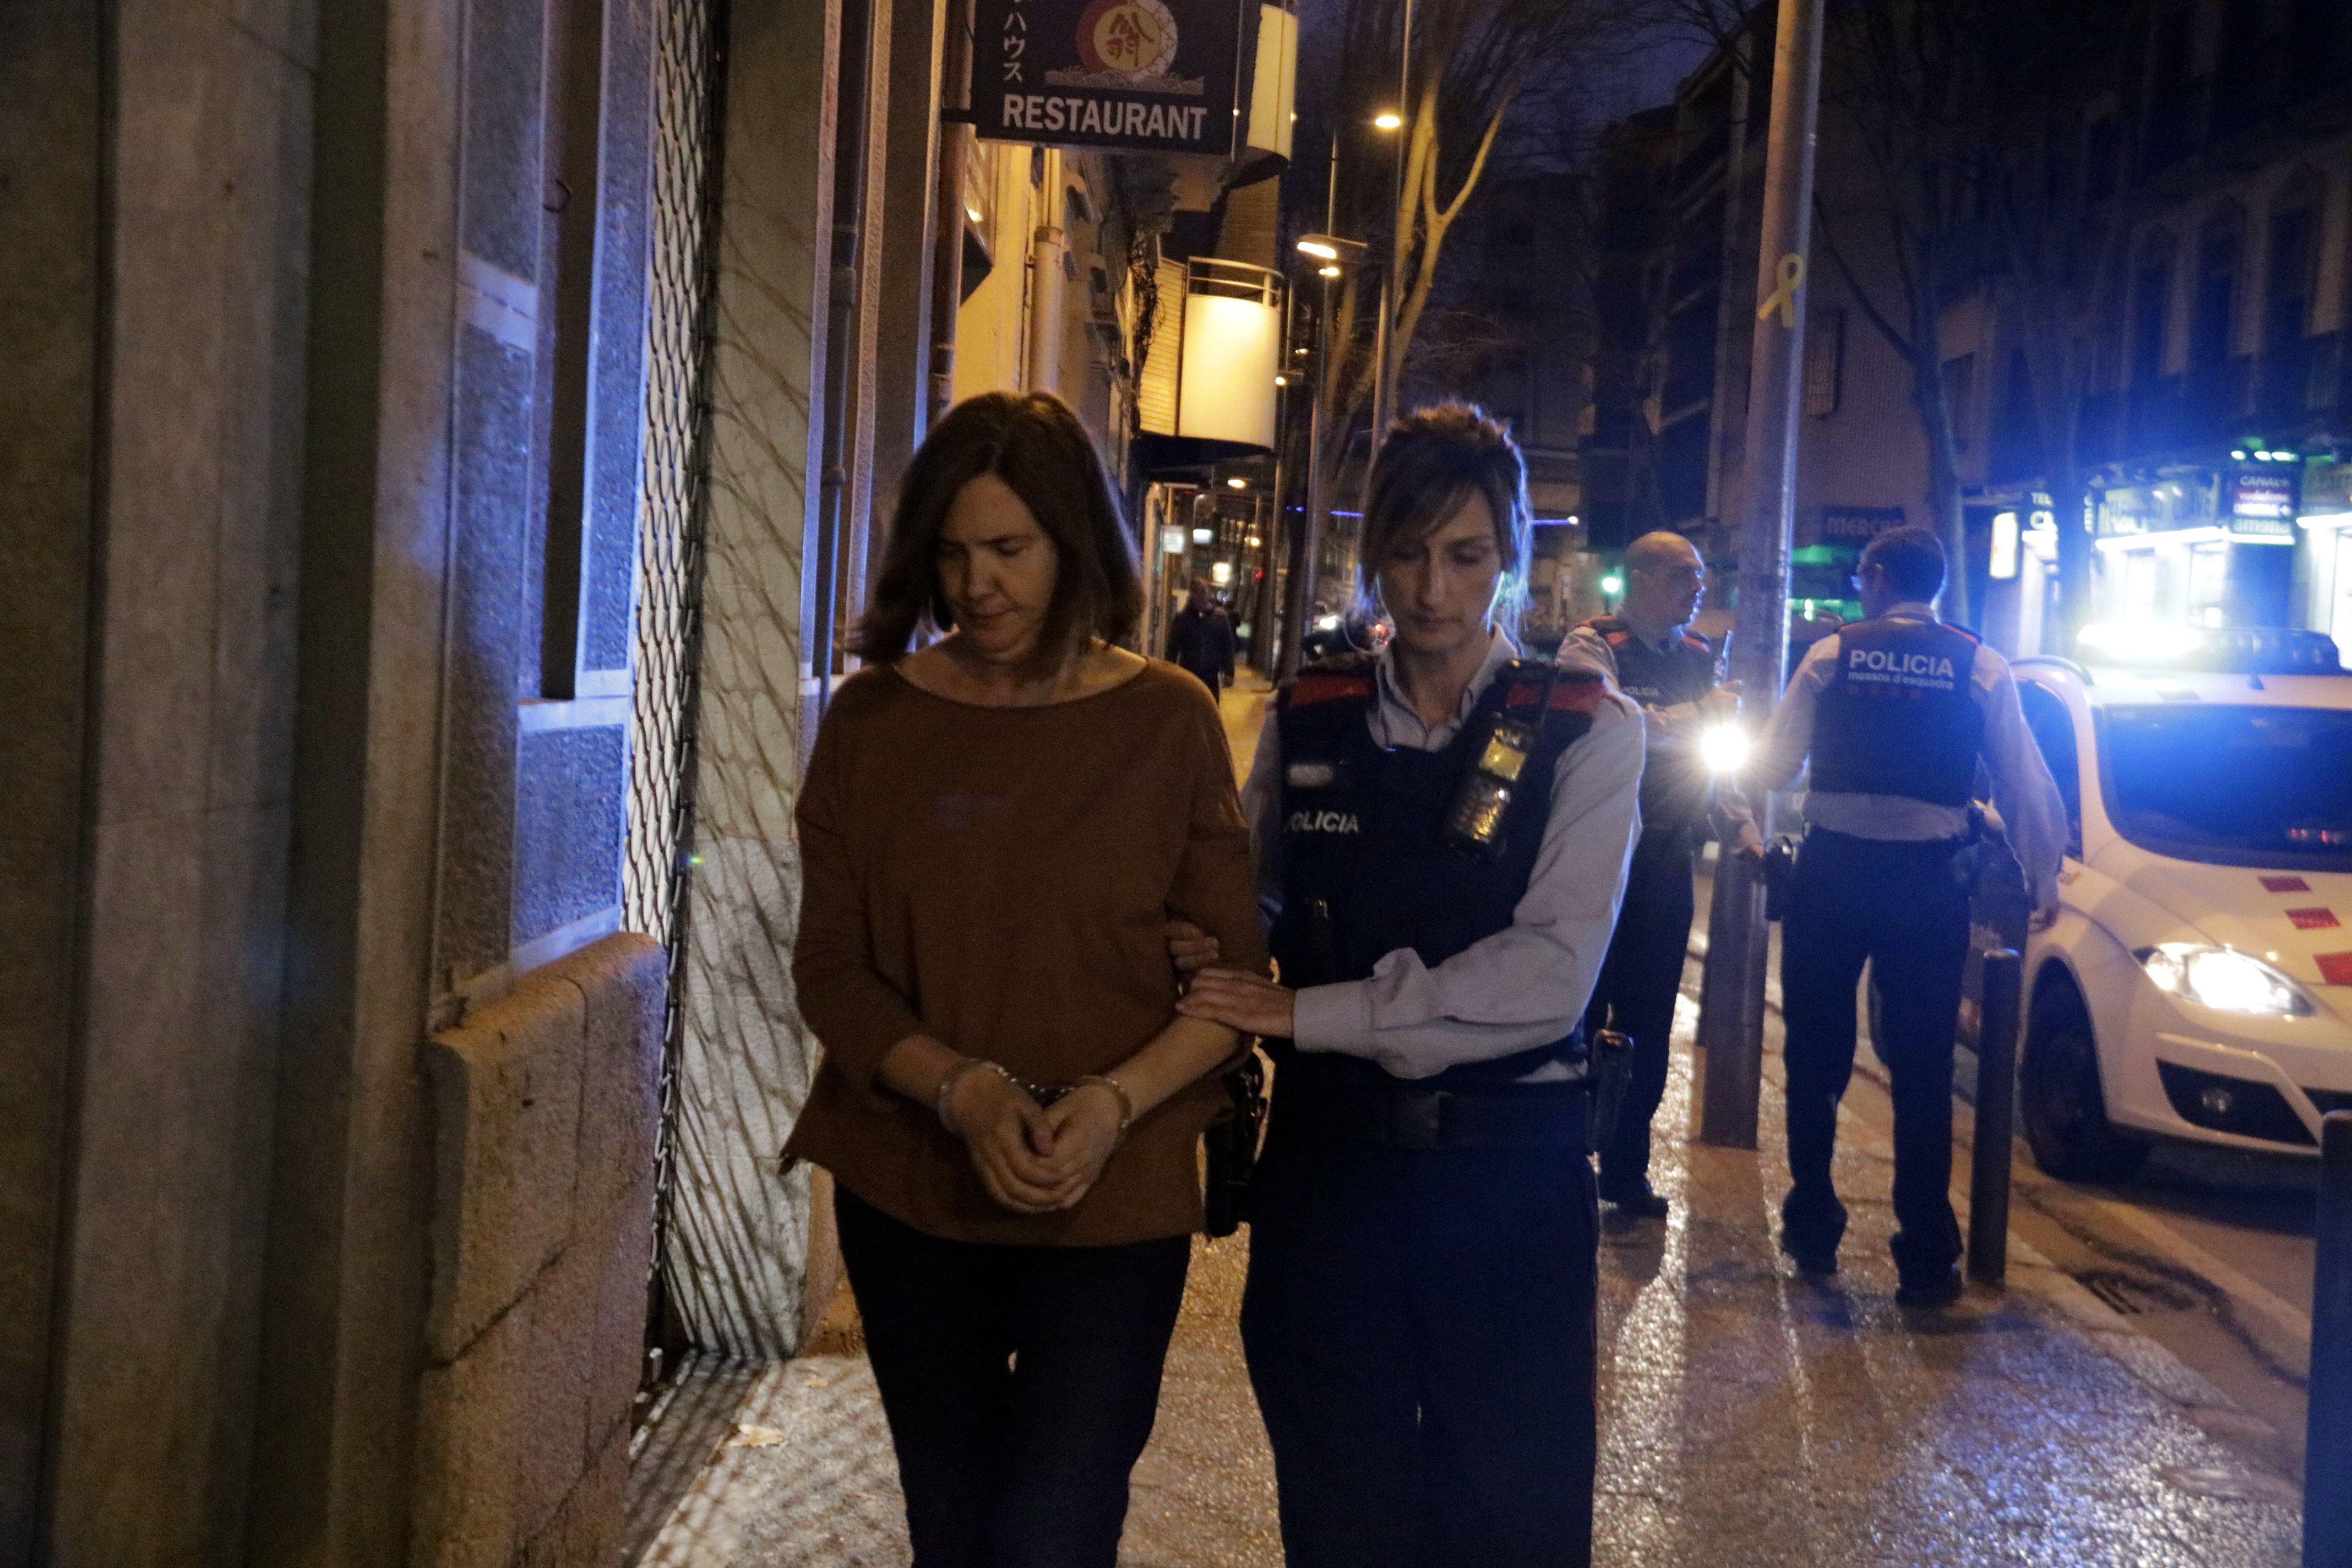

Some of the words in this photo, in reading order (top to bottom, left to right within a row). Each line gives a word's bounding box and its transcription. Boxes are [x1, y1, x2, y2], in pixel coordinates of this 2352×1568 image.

[1003, 0, 1026, 82] ハウス
[1002, 93, 1207, 140] RESTAURANT
[1849, 649, 1954, 678] POLICIA
